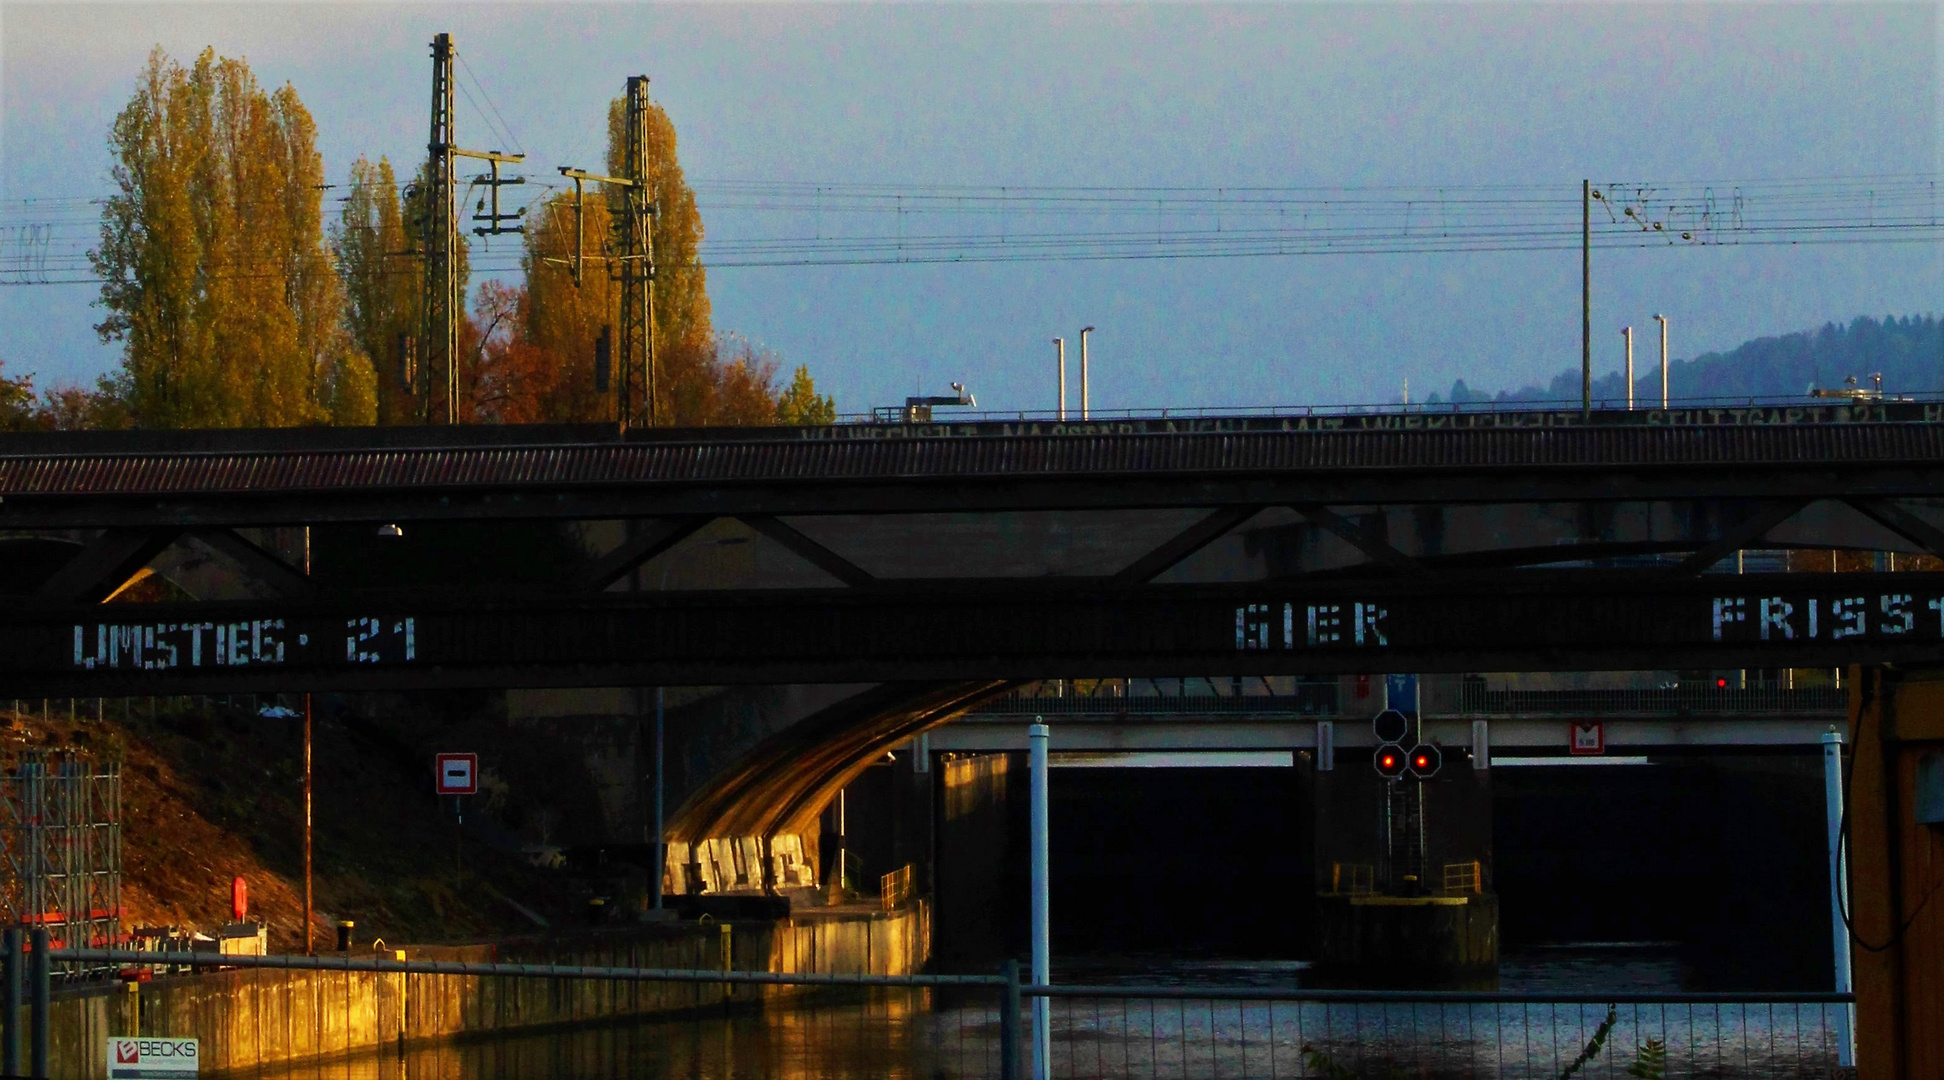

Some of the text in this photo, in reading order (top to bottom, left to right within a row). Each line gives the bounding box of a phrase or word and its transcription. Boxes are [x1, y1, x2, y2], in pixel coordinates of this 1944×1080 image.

[1647, 408, 1827, 425] STUTTGART
[346, 616, 416, 663] 21
[1235, 602, 1389, 651] GIER
[139, 1040, 197, 1058] BECKS
